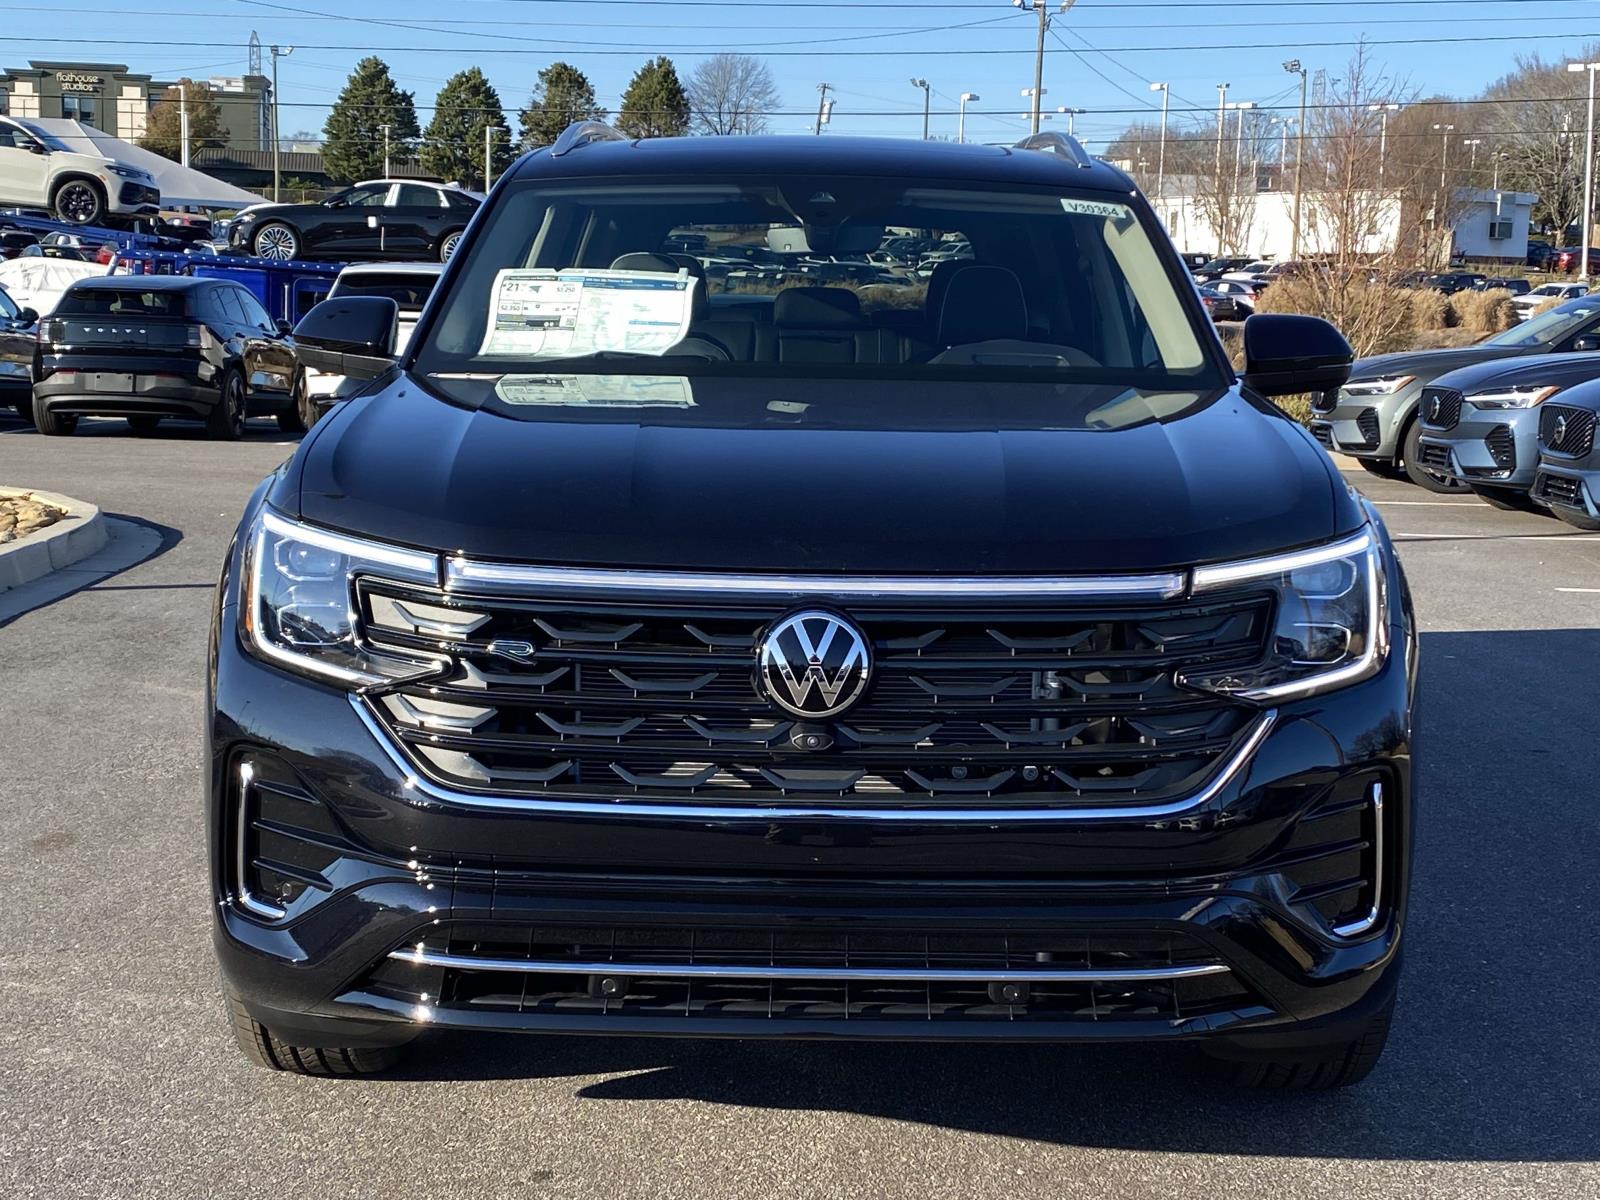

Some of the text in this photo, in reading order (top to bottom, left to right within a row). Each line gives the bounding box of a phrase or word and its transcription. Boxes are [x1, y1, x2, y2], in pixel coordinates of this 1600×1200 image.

[56, 71, 98, 82] flathouse
[61, 81, 93, 91] studios
[1068, 202, 1119, 216] V30364
